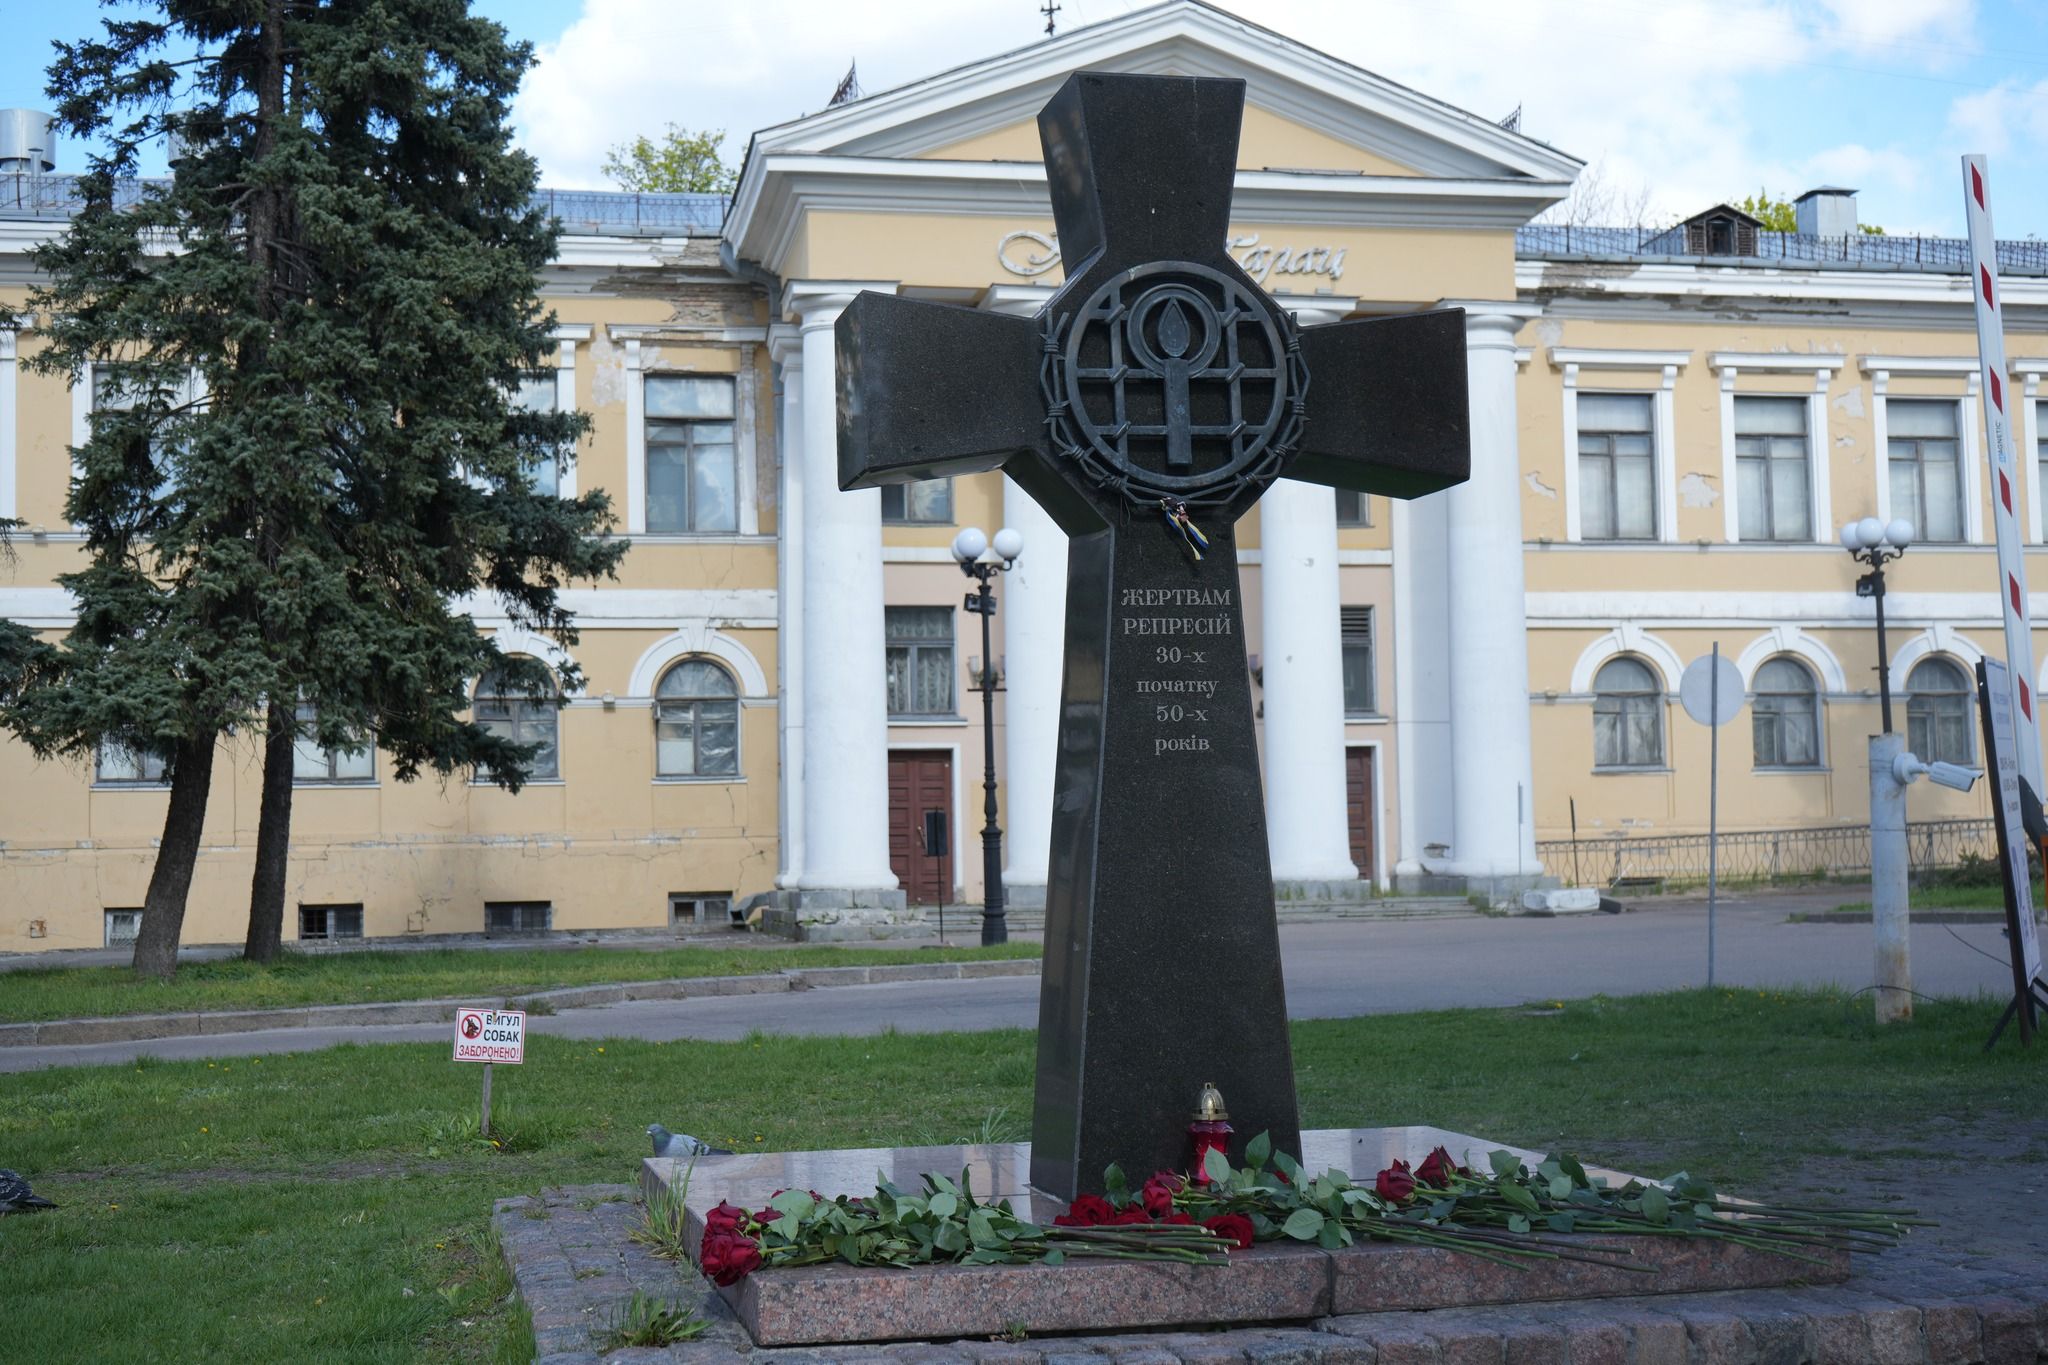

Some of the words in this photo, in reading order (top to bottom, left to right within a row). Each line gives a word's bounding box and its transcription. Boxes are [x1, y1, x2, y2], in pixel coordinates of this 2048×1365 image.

[1121, 588, 1231, 606] ЖЕРТВАМ
[1122, 613, 1232, 635] РЕПРЕСІЙ
[1156, 646, 1208, 664] 30-х
[1136, 680, 1219, 699] початку
[1156, 704, 1209, 722] 50-х
[1155, 734, 1210, 756] років
[483, 1029, 520, 1043] СОБАК
[458, 1044, 519, 1060] ЗАБОРОНЕНО!
